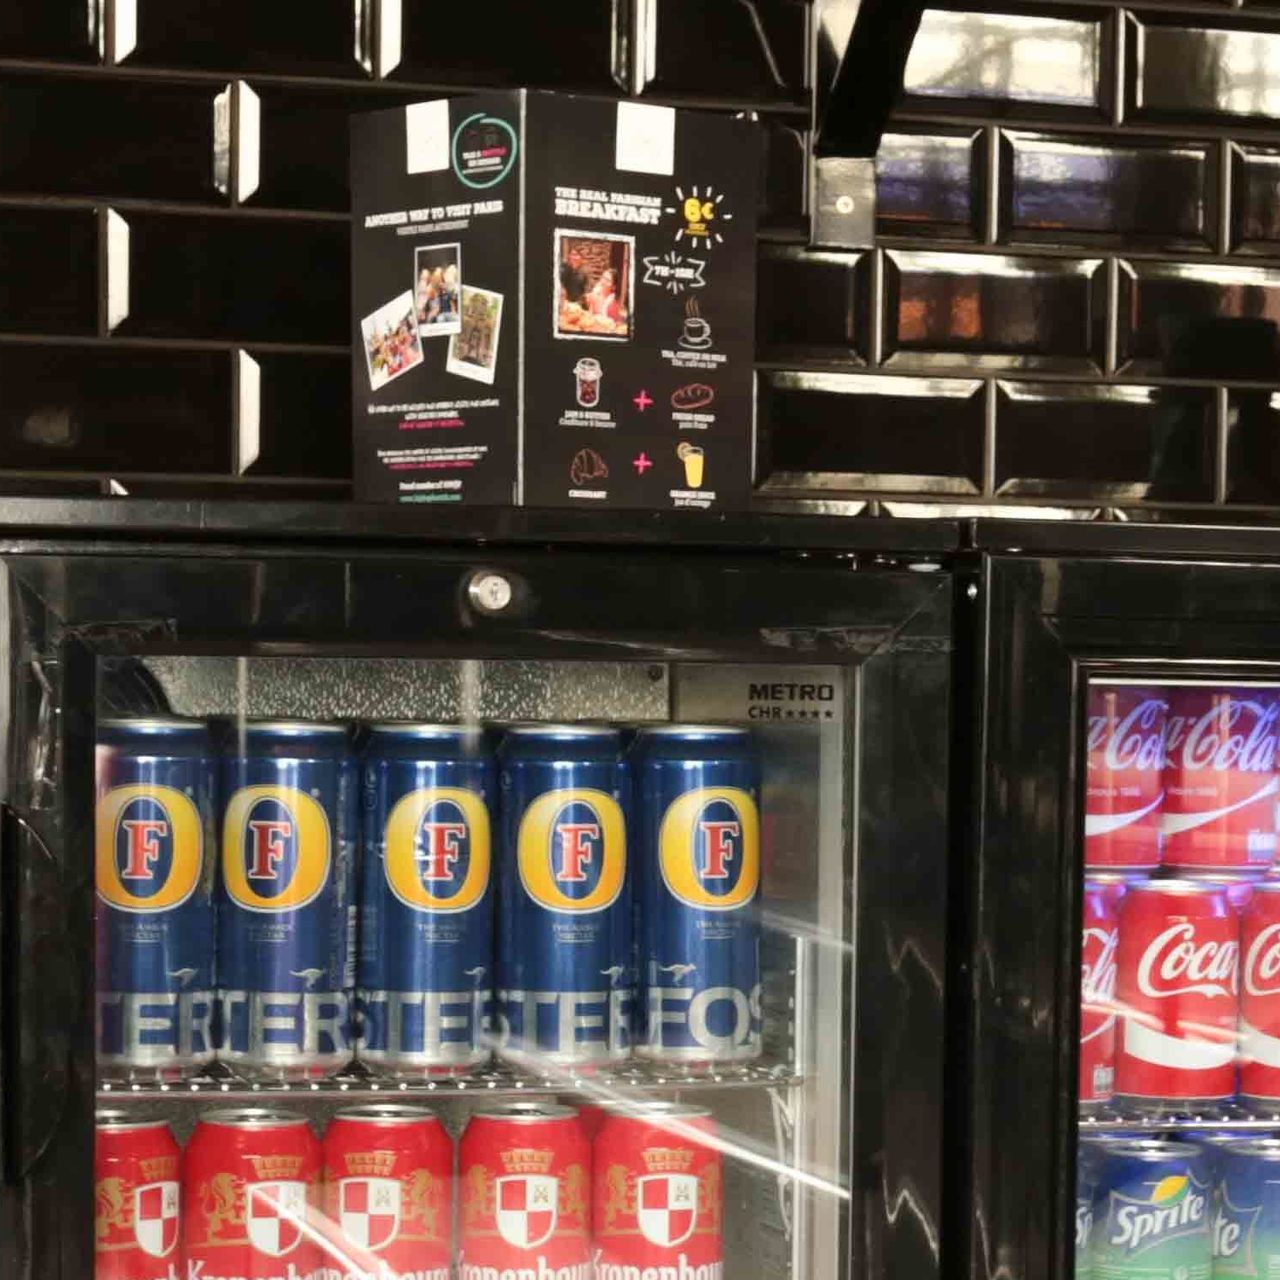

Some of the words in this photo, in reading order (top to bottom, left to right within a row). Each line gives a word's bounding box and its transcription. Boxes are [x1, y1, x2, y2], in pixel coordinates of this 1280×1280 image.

[555, 199, 661, 225] BREAKFAST
[748, 683, 834, 701] METRO
[1111, 1189, 1206, 1249] Sprite
